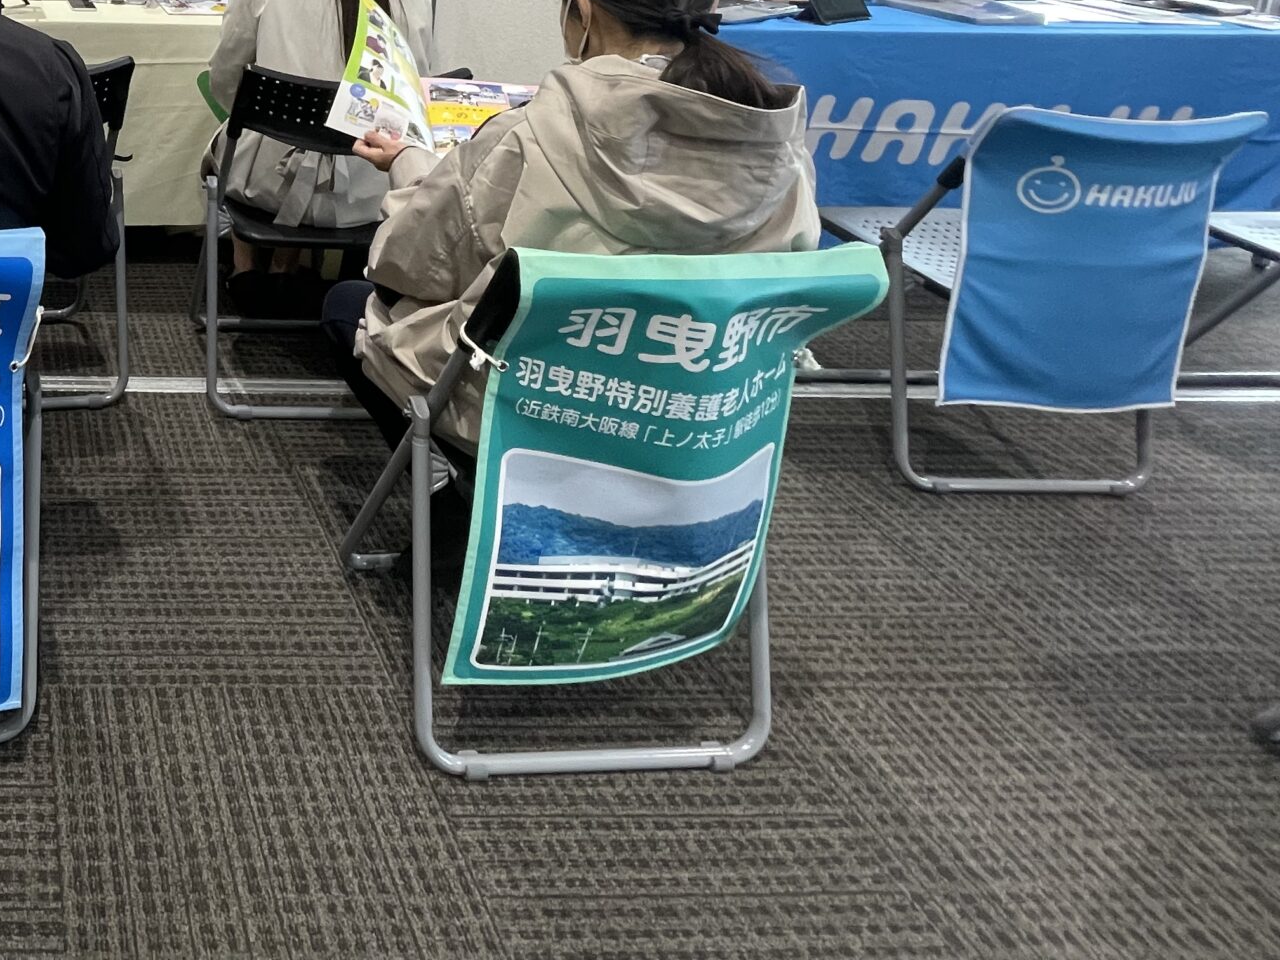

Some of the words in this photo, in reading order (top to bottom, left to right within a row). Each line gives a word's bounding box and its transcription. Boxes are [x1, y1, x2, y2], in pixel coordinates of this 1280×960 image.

[1085, 180, 1199, 209] HAKUJU
[558, 304, 829, 373] 羽曳野市
[516, 352, 786, 423] 羽曳野特別養護老人ホーム
